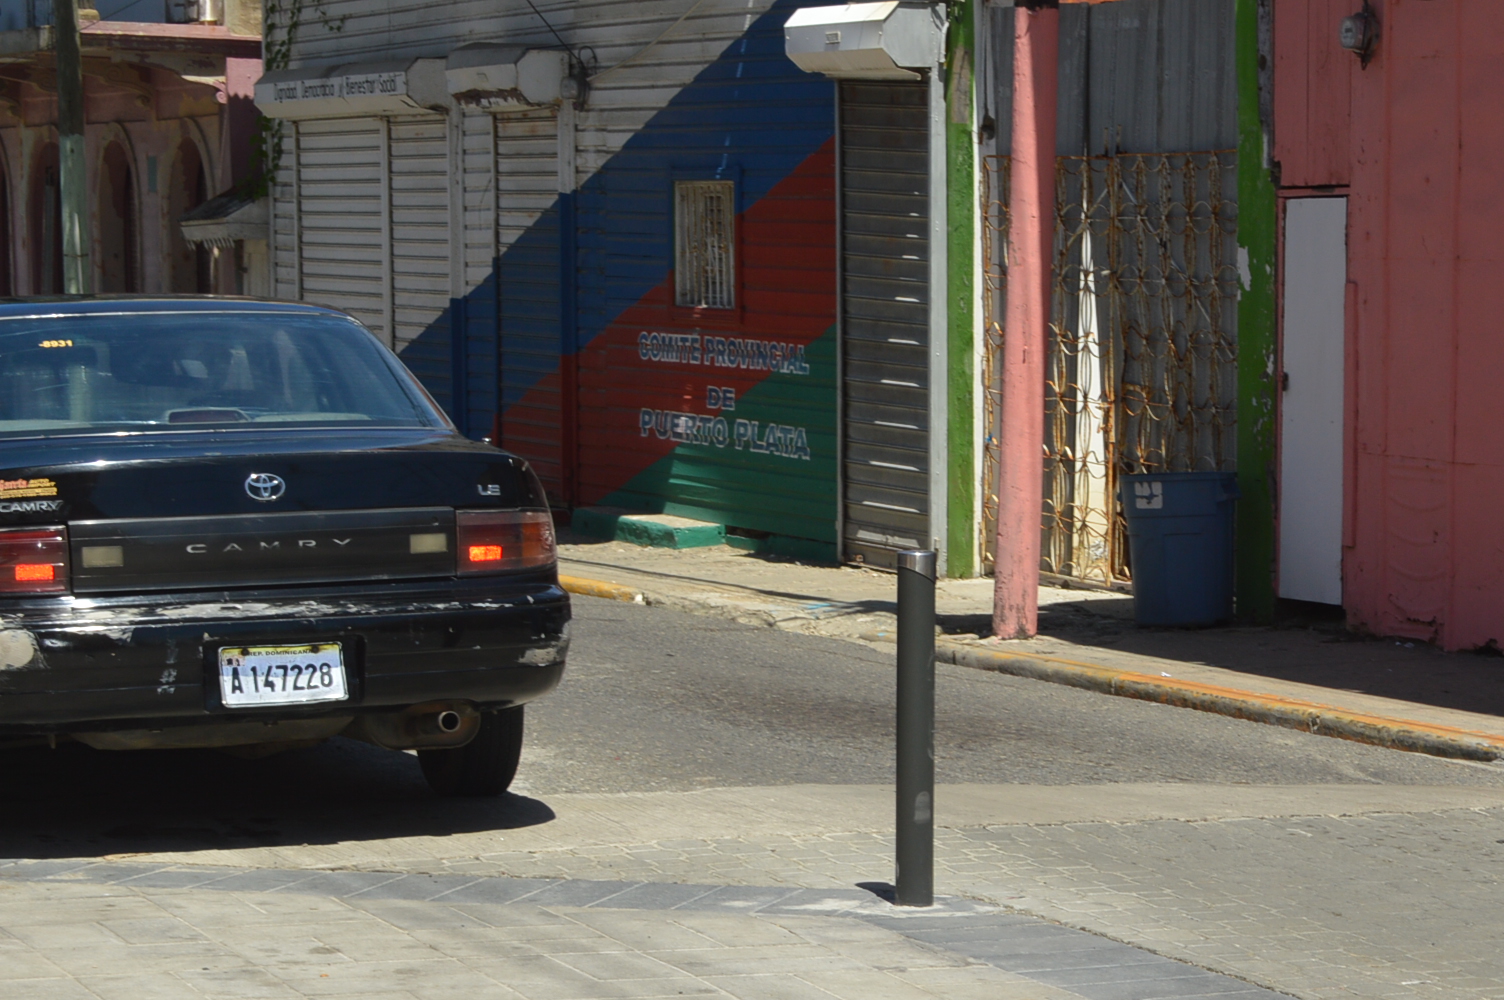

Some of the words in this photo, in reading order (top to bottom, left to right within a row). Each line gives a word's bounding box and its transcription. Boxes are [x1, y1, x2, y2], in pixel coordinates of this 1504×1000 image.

[638, 327, 702, 365] COMITÉ
[704, 335, 810, 375] PROVINCIAL
[706, 385, 736, 410] DE
[639, 408, 729, 448] PUERTO
[733, 418, 811, 461] PLATA
[477, 484, 502, 496] LE
[0, 500, 63, 513] CAMRY
[186, 538, 352, 554] CAMRY
